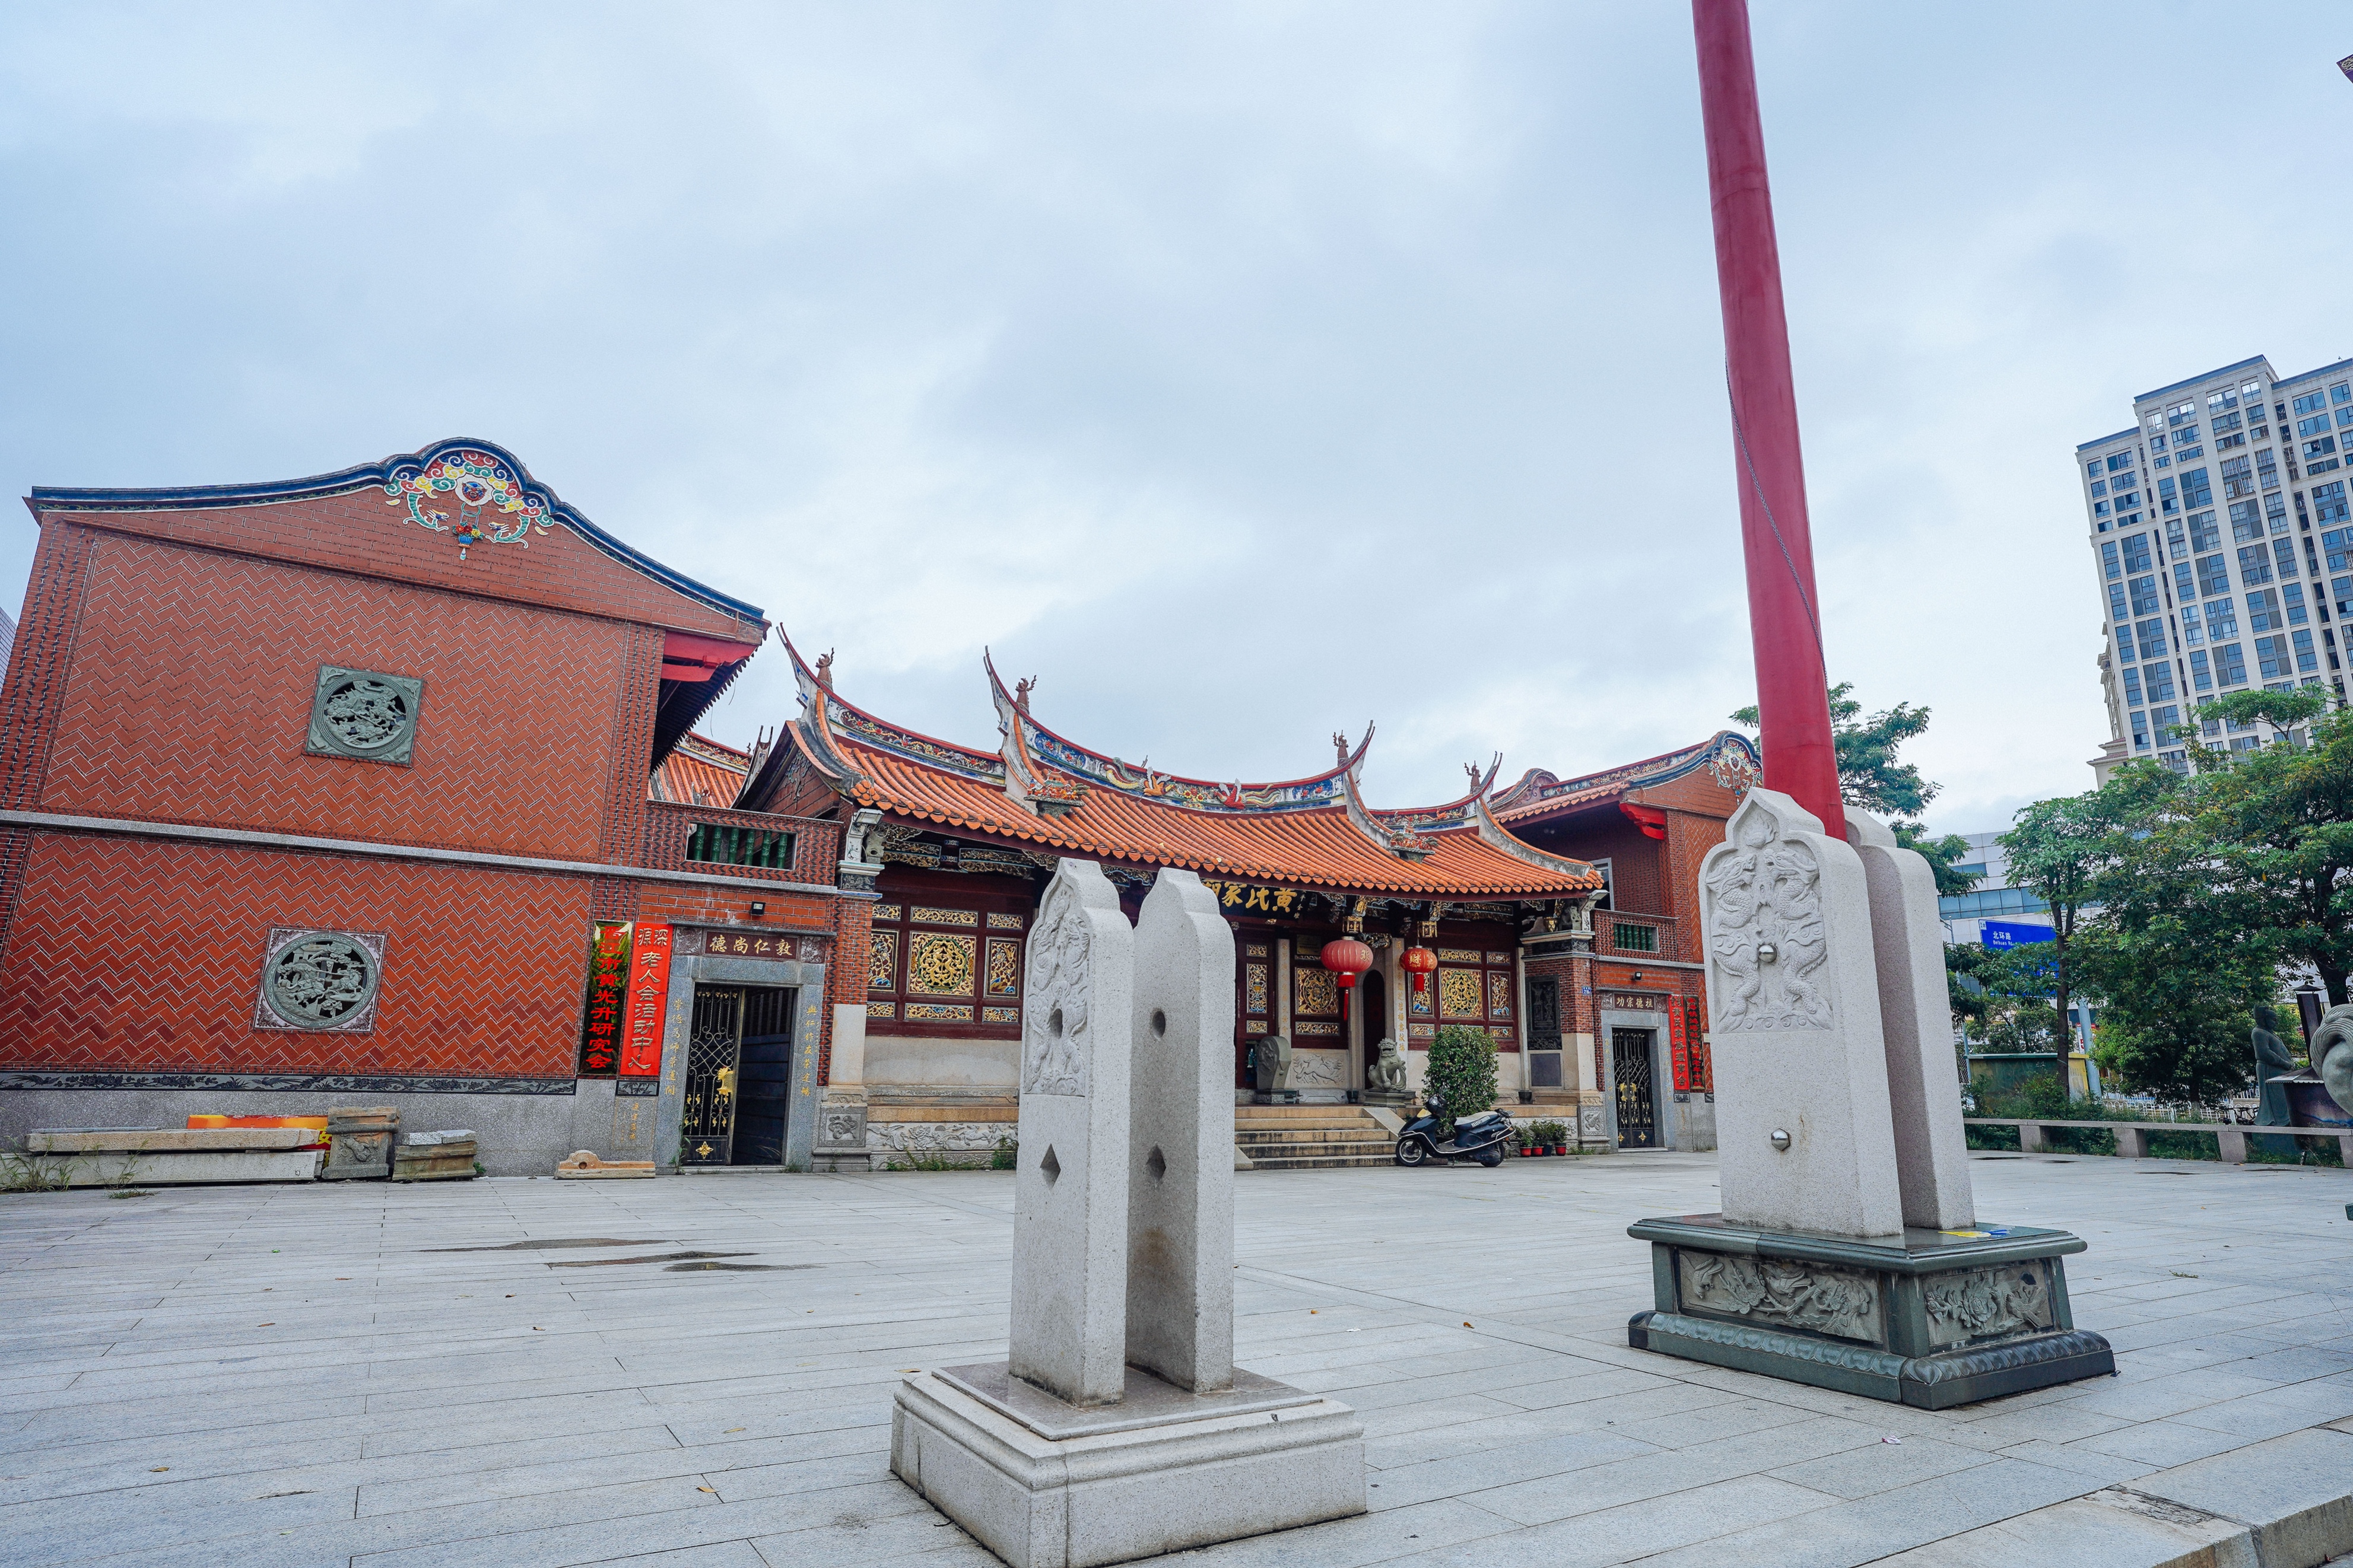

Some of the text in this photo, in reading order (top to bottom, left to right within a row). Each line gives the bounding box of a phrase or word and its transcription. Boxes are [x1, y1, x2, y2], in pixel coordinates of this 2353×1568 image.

[1993, 931, 2011, 940] 北环路
[585, 925, 628, 1068] 晋江市黄光升研究会
